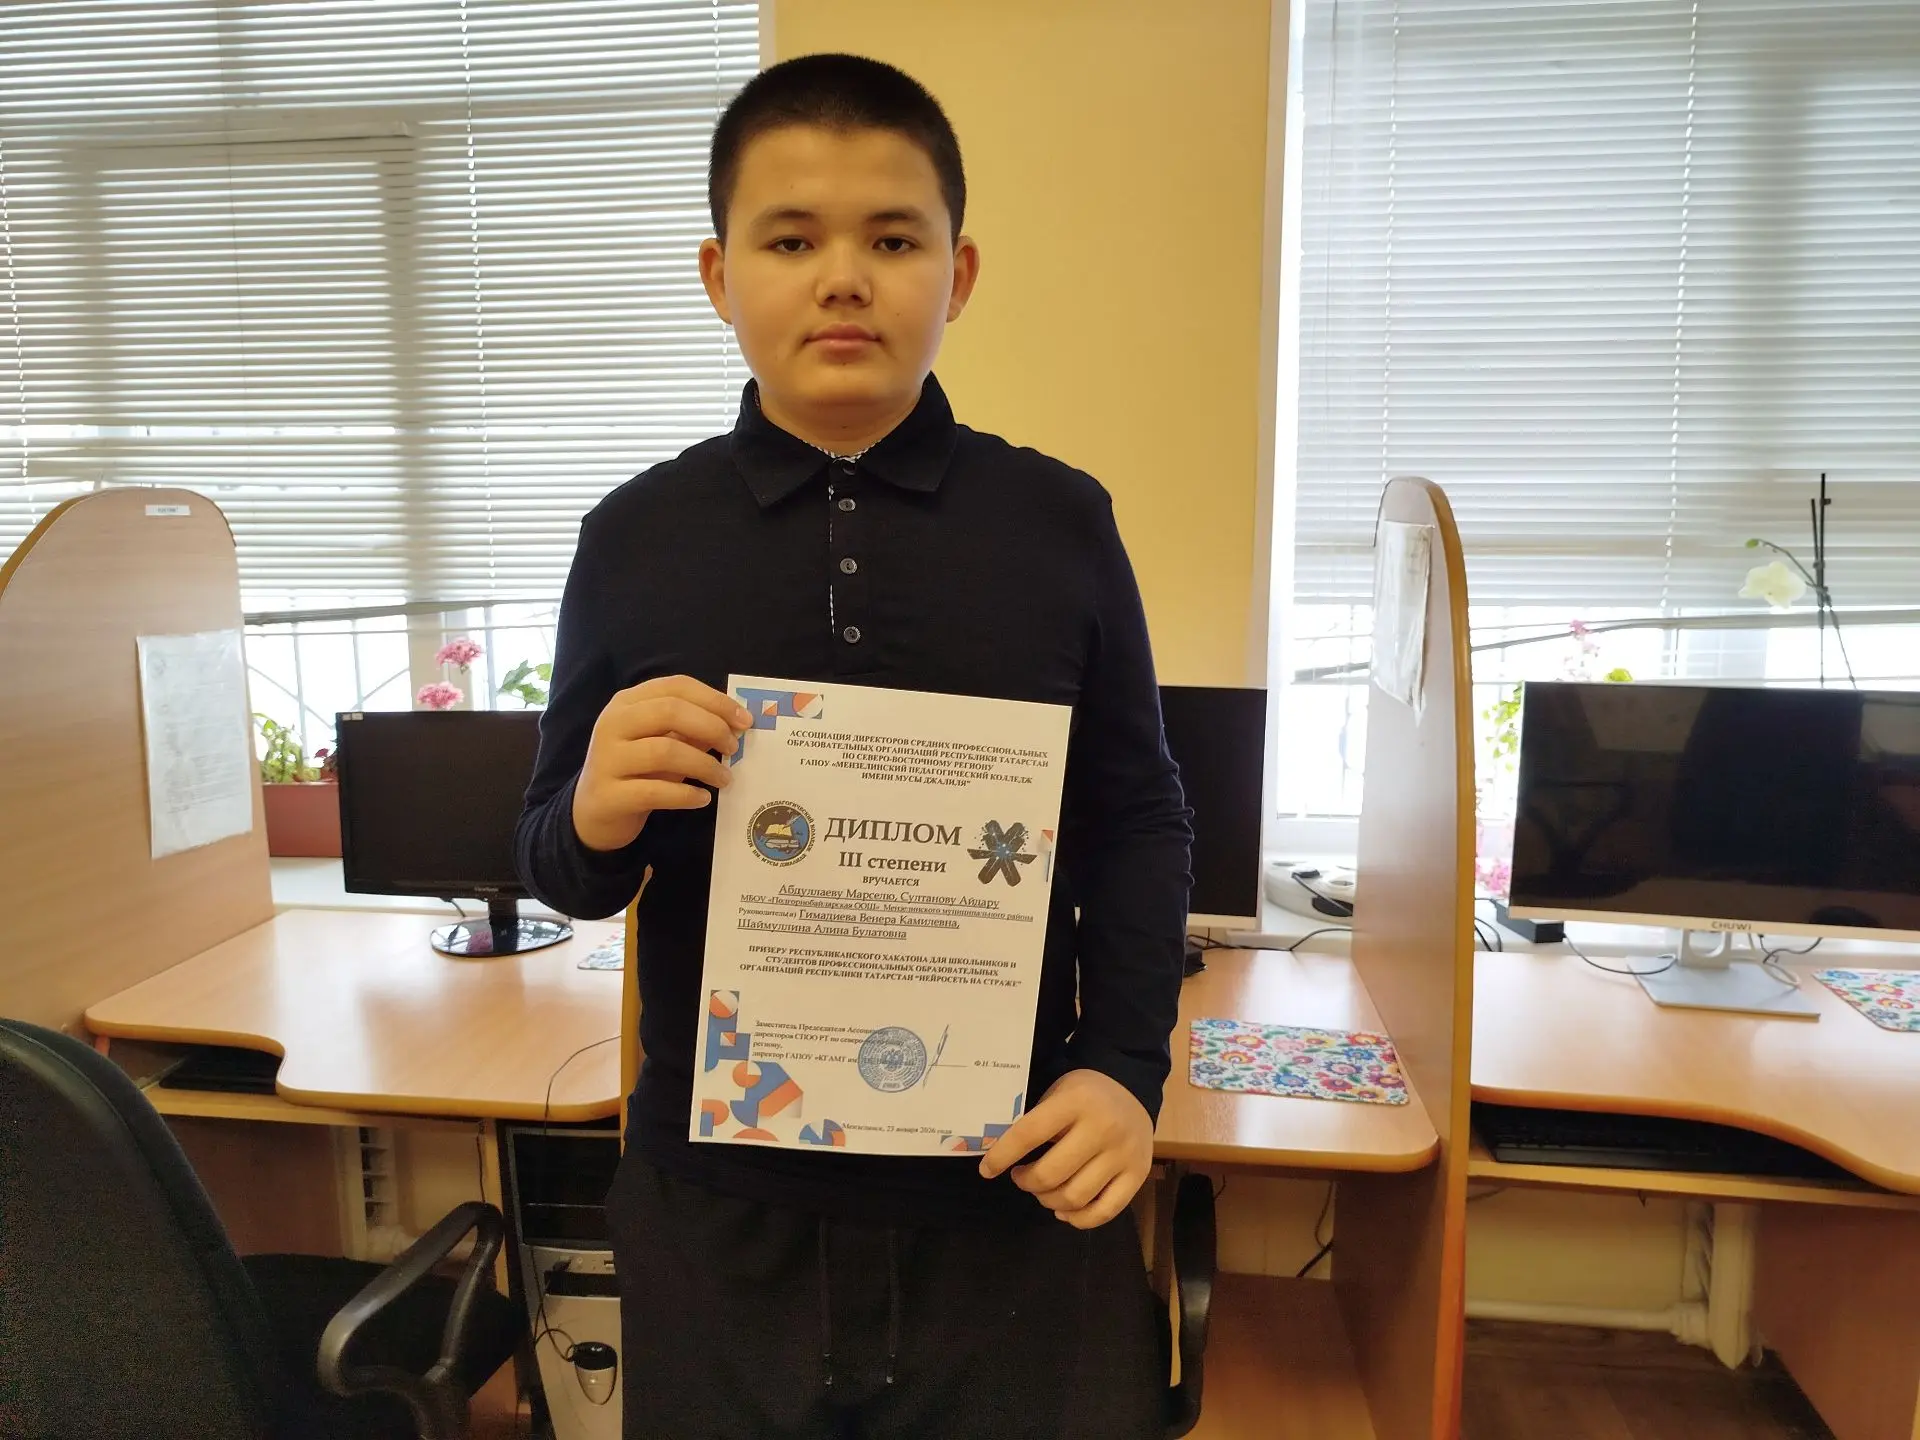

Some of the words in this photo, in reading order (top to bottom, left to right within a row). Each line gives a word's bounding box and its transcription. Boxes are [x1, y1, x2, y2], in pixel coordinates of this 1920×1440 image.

[787, 739, 874, 752] ОБРАЗОВАТЕЛЬНЫХ
[875, 746, 938, 757] ОРГАНИЗАЦИЙ
[940, 751, 997, 762] РЕСПУБЛИКИ
[999, 756, 1049, 767] ТАТАРСТАН
[790, 730, 851, 741] АССОЦИАЦИЯ
[853, 735, 909, 745] ДИРЕКТОРОВ
[910, 739, 950, 749] СРЕДНИХ
[952, 743, 1048, 758] ПРОФЕССИОНАЛЬНЫХ
[800, 759, 830, 767] ГАПОУ
[832, 760, 907, 773] «МЕНЗЕЛИНСКИЙ
[909, 767, 988, 780] ПЕДАГОГИЧЕСКИЙ
[990, 774, 1033, 784] КОЛЛЕДЖ
[842, 752, 855, 760] ПО
[857, 753, 952, 767] СЕВЕРО-ВОСТОЧНОМУ
[954, 761, 994, 771] РЕГИОНУ
[861, 772, 893, 781] ИМЕНИ
[895, 774, 922, 783] МУСЫ
[923, 776, 971, 787] ДЖАЛИЛЯ"
[823, 817, 962, 846] ДИПЛОМ
[838, 851, 863, 868] III
[867, 857, 947, 873] степени
[862, 876, 920, 887] ВРУЧАЕТСЯ
[779, 884, 844, 900] Абдуллаеву
[846, 889, 897, 901] Марселю,
[900, 891, 956, 905] Султанову
[959, 895, 1000, 909] Айдару
[740, 894, 766, 902] МБОУ
[883, 904, 941, 914] Мензелинского
[942, 908, 1006, 919] муниципального
[1007, 912, 1034, 922] района
[737, 918, 811, 933] Шаймуллина
[814, 924, 849, 935] Алина
[852, 927, 907, 938] Булатовна
[799, 909, 857, 922] Гимадиева
[859, 913, 896, 925] Венера
[899, 915, 960, 928] Камилевна,
[1711, 921, 1752, 930] CHUWI
[748, 945, 787, 954] ПРИЗЕРУ
[789, 948, 881, 960] РЕСПУБЛИКАНСКОГО
[882, 953, 928, 963] ХАКАТОНА
[929, 956, 947, 964] ДЛЯ
[948, 957, 1009, 968] ШКОЛЬНИКОВ
[765, 956, 817, 966] СТУДЕНТОВ
[818, 959, 914, 972] ПРОФЕССИОНАЛЬНЫХ
[915, 965, 999, 976] ОБРАЗОВАТЕЛЬНЫХ
[740, 964, 803, 975] ОРГАНИЗАЦИЙ
[805, 969, 862, 978] РЕСПУБЛИКИ
[864, 972, 913, 981] ТАТАРСТАН
[970, 977, 982, 985] НА
[754, 1031, 794, 1040] директоров
[756, 1020, 797, 1030] Заместитель
[798, 1024, 846, 1033] Председателя
[752, 1051, 784, 1060] директор
